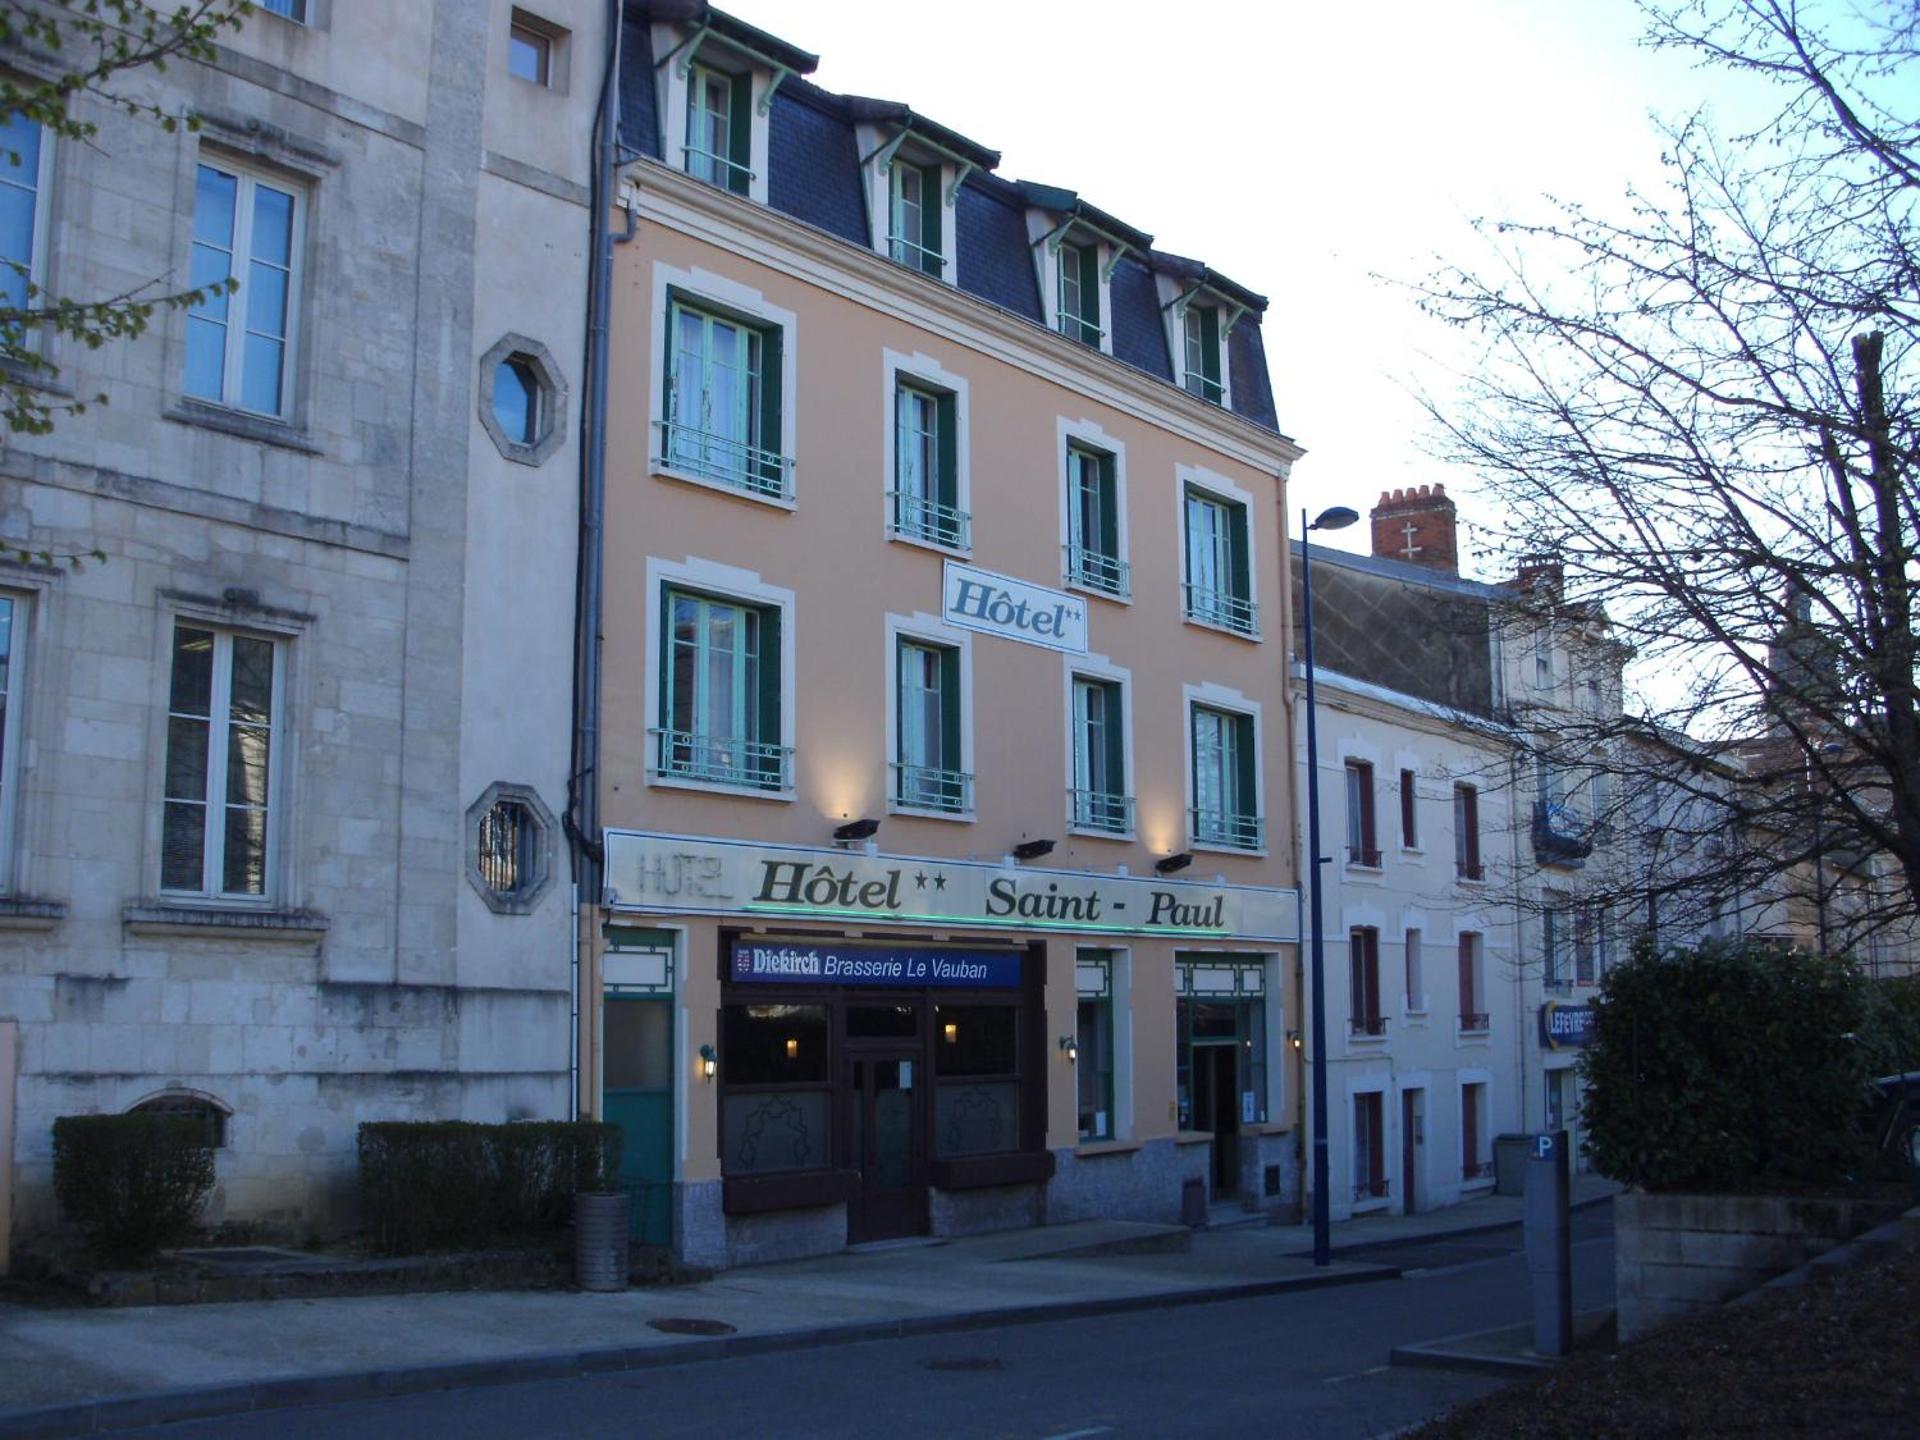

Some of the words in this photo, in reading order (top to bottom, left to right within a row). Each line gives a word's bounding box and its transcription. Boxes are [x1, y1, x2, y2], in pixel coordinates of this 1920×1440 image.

[949, 578, 1066, 639] Hôtel
[753, 860, 902, 909] Hôtel
[1145, 891, 1225, 928] Paul
[753, 948, 821, 975] Diekirch
[824, 955, 901, 977] Brasserie
[907, 958, 926, 977] Le
[932, 958, 987, 979] Vauban
[1539, 1136, 1553, 1158] P
